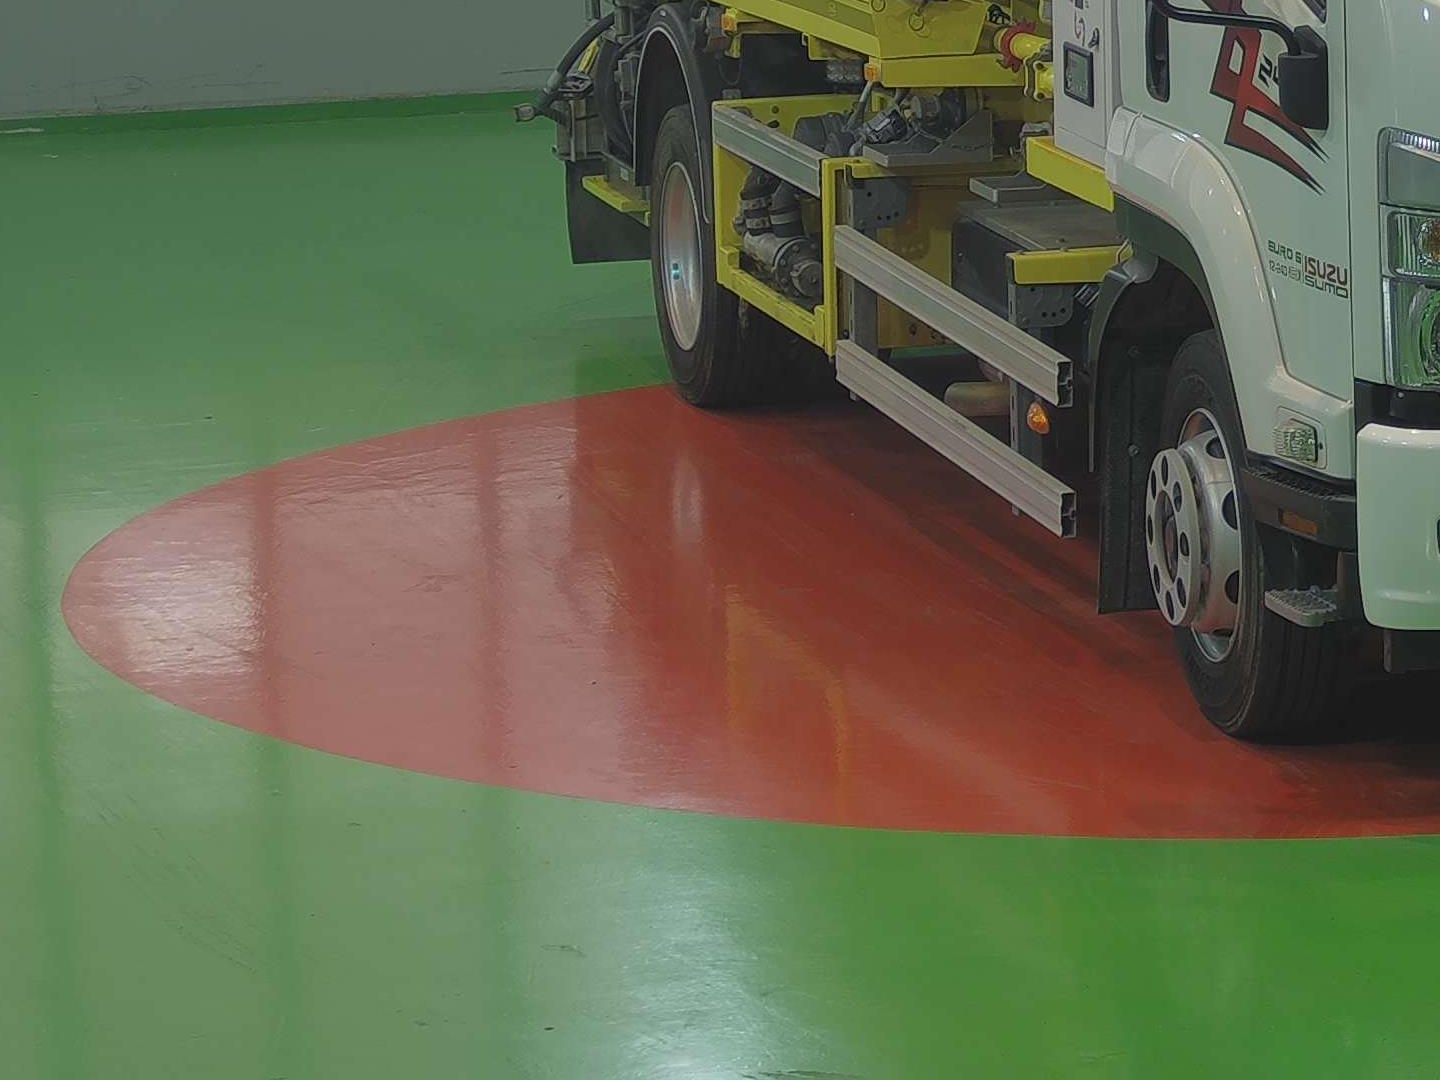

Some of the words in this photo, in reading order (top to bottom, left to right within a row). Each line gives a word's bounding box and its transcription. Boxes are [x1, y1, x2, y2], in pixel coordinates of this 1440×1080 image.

[1267, 239, 1294, 261] EURO
[1304, 255, 1348, 286] ISUZU
[1304, 274, 1349, 299] SUMO
